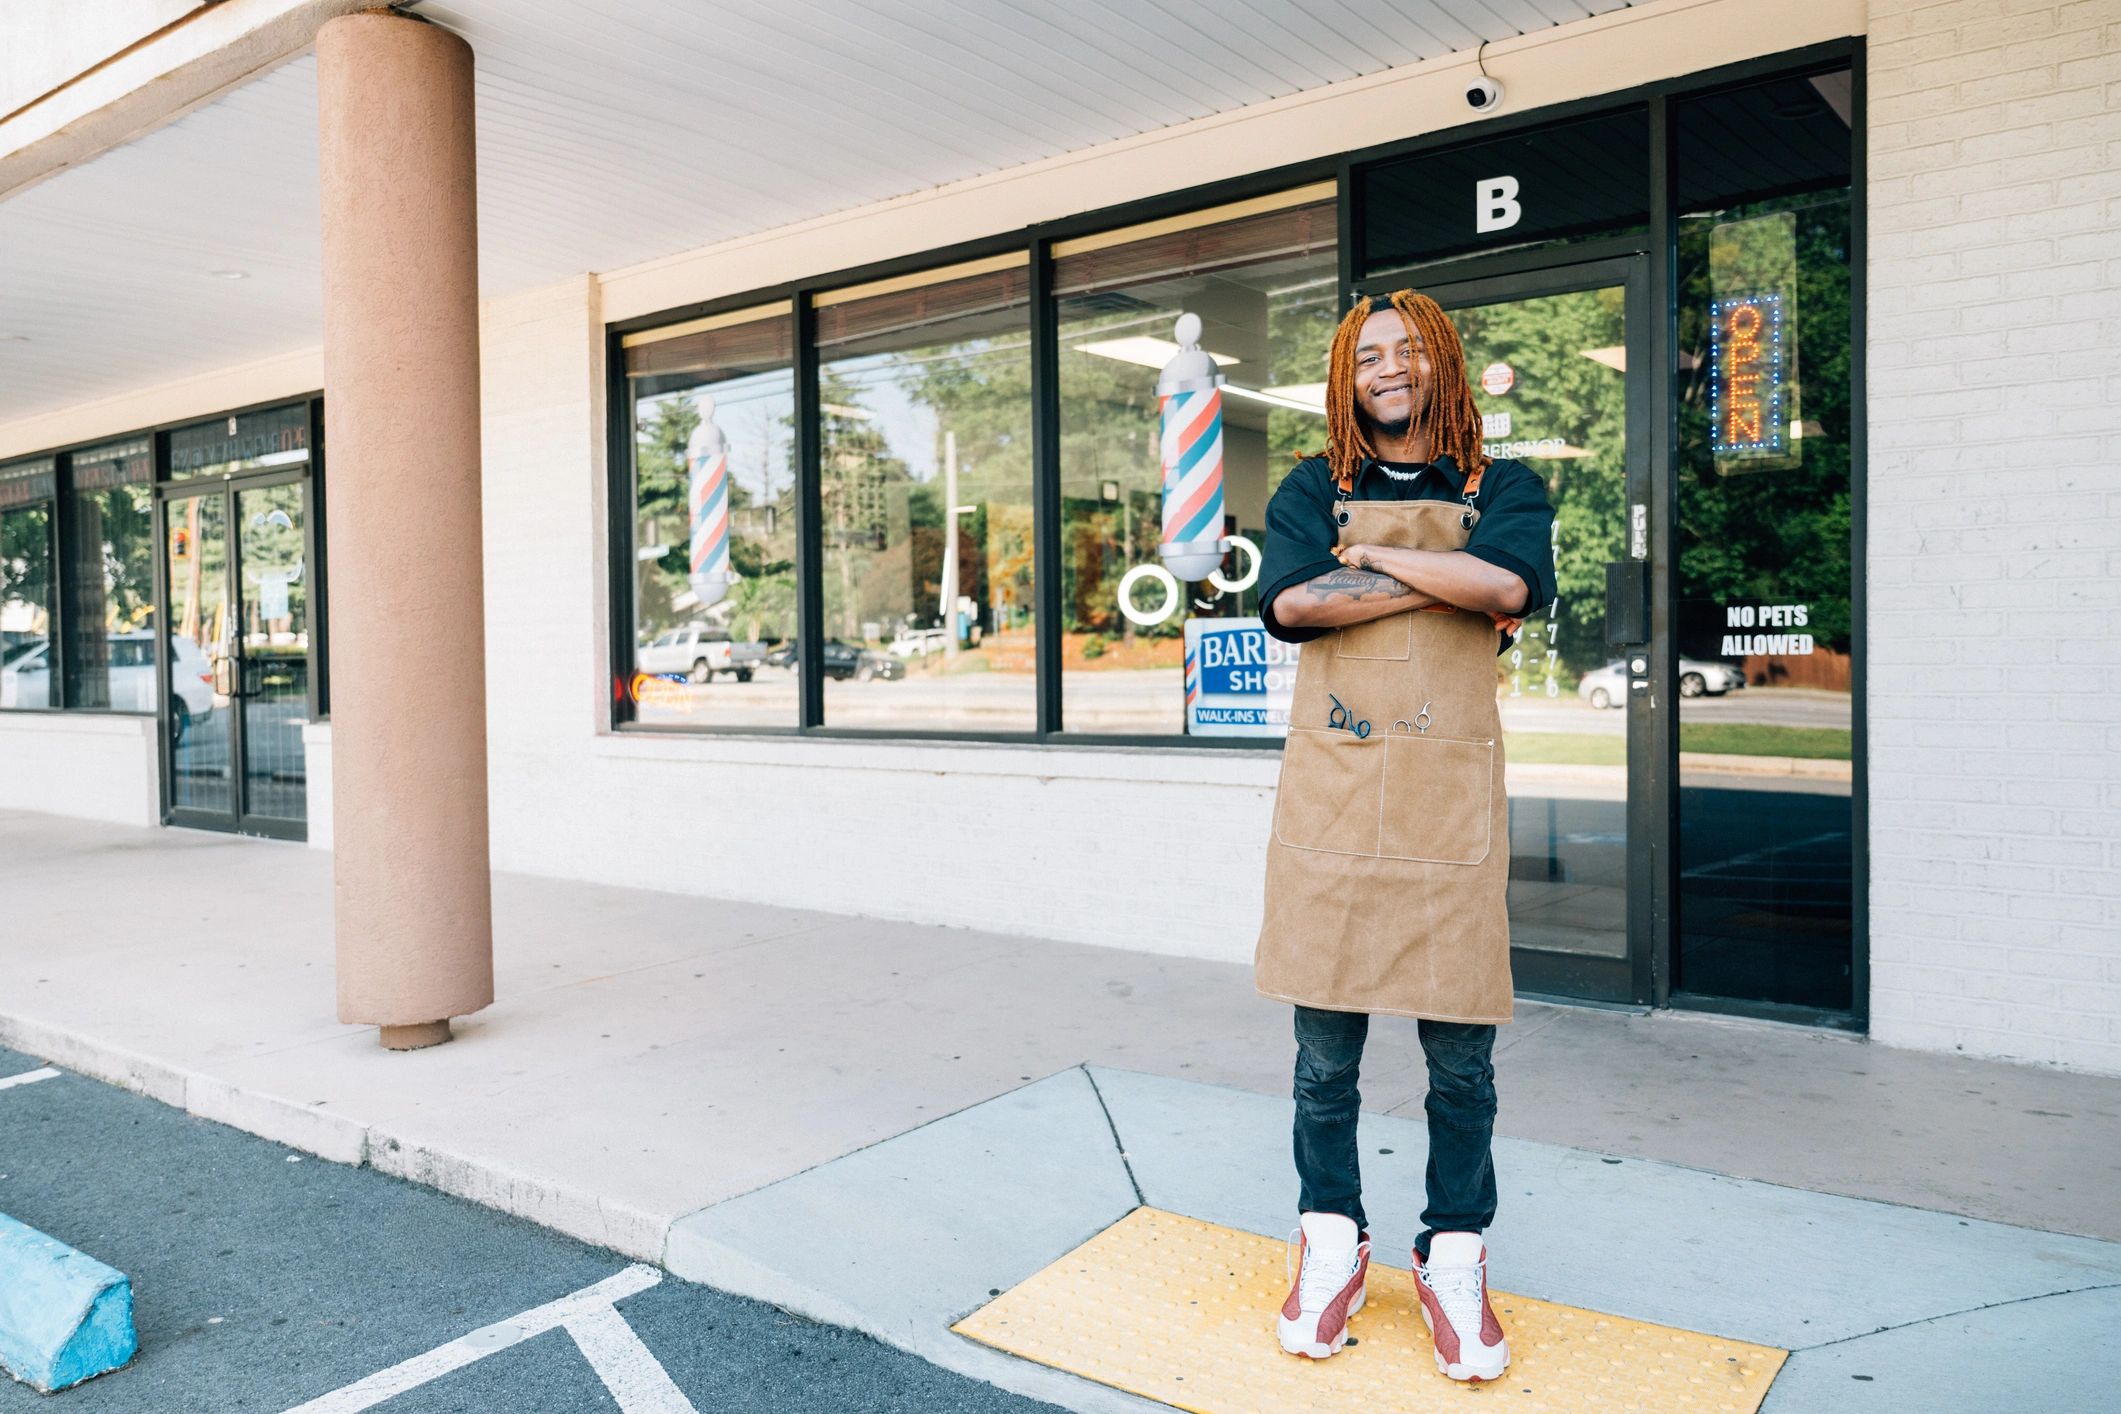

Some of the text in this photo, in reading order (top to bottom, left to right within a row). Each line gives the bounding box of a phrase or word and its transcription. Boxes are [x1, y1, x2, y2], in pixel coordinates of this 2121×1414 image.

[1476, 175, 1521, 234] B
[1729, 304, 1761, 443] OPEN
[1482, 437, 1566, 459] BERSHOP
[1727, 604, 1808, 628] NO PETS
[1203, 631, 1300, 668] BARBE
[1721, 634, 1814, 656] ALLOWED
[1197, 709, 1290, 723] WALK-INS WELC
